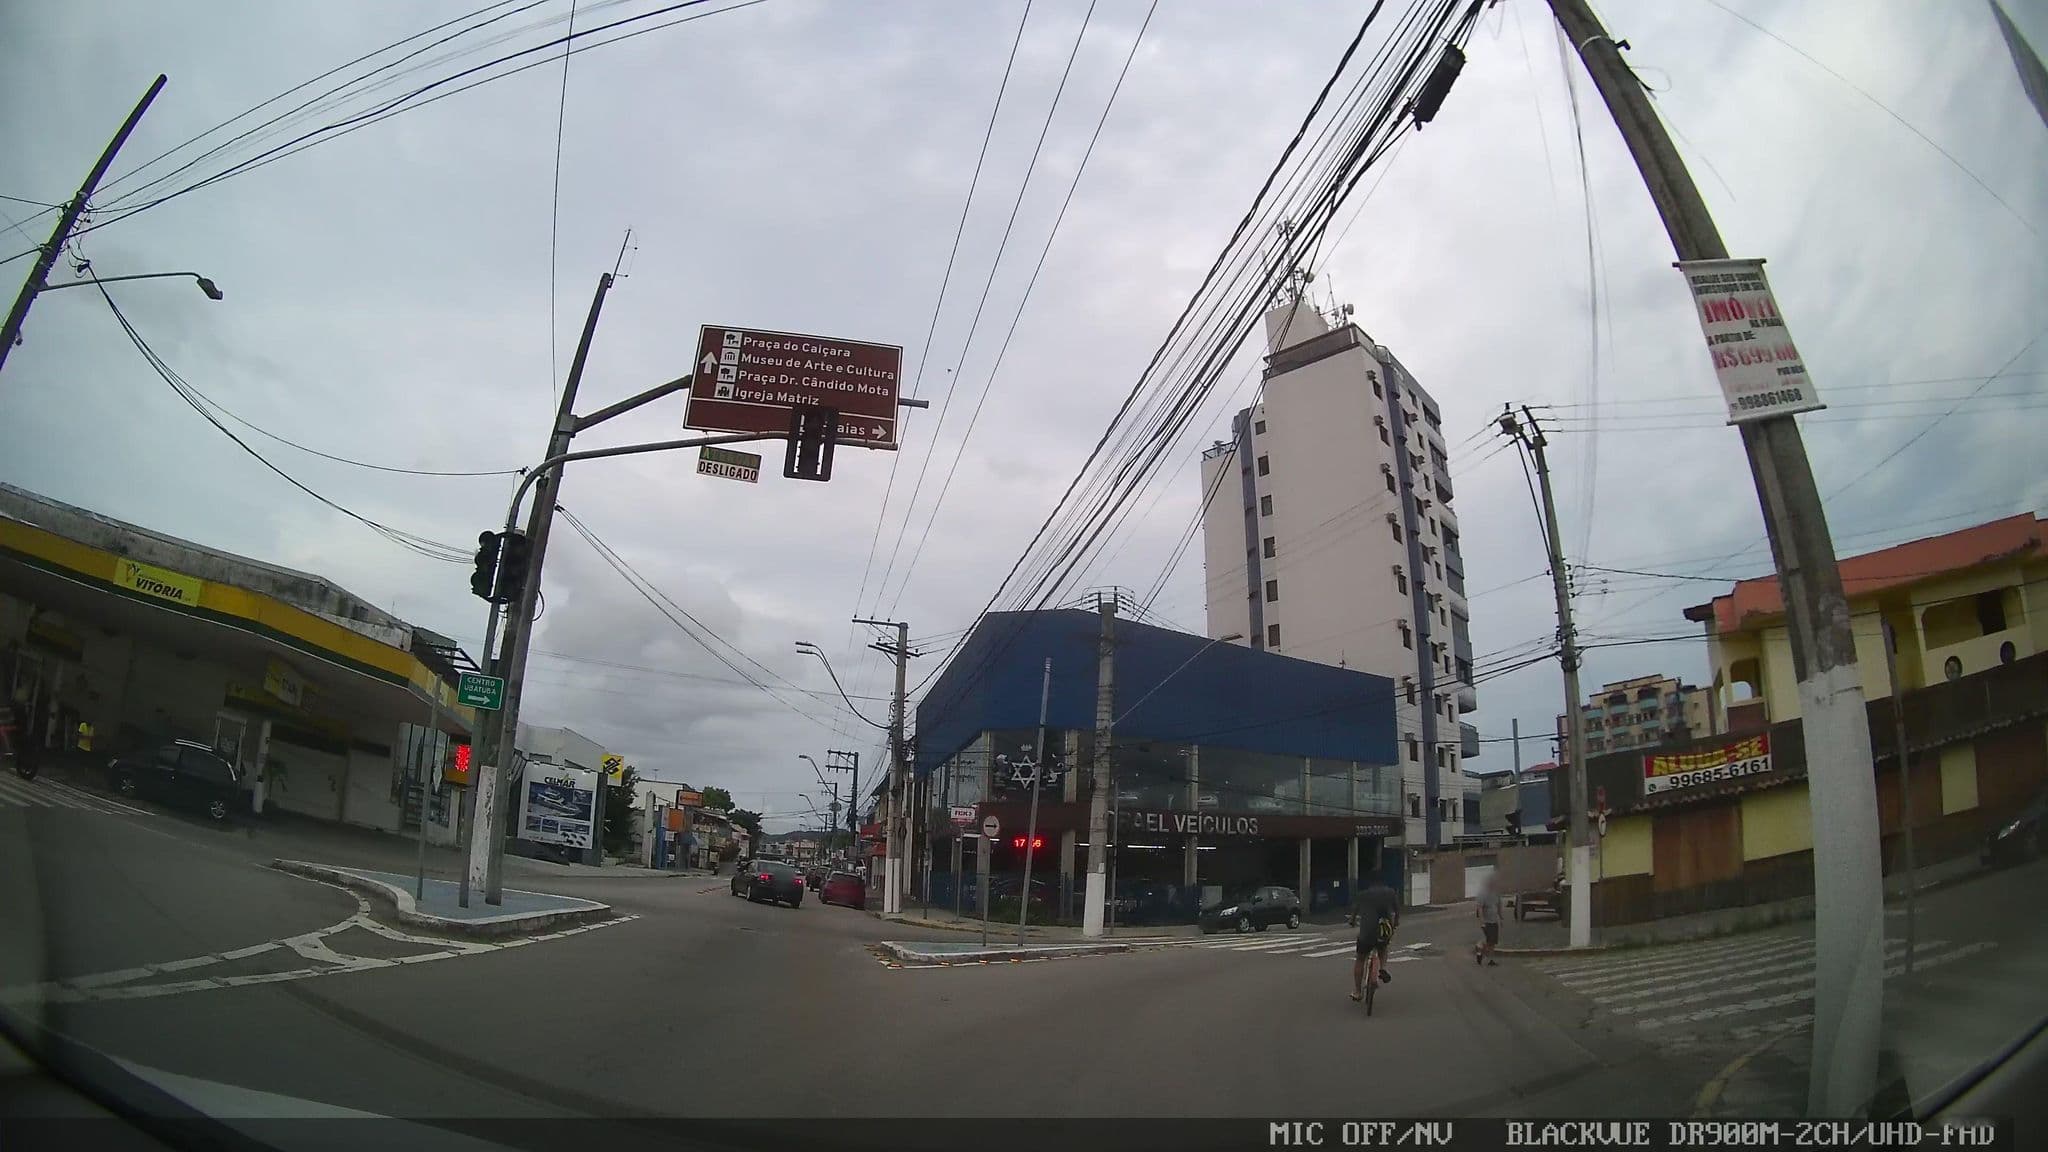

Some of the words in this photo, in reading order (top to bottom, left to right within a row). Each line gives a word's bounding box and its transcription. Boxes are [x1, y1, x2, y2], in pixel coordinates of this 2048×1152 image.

[743, 337, 781, 351] Praça
[783, 341, 799, 351] do
[802, 343, 852, 358] Caiçara
[741, 352, 783, 366] Museu
[785, 358, 801, 368] de
[804, 360, 833, 372] Arte
[836, 365, 844, 373] e
[846, 364, 895, 380] Cultura
[738, 370, 776, 385] Praça
[779, 374, 799, 386] Dr.
[802, 376, 854, 392] Cândido
[857, 383, 889, 396] Mota
[735, 388, 774, 402] Igreja
[776, 391, 820, 406] Matriz
[837, 423, 866, 435] aias
[699, 461, 757, 481] DESLIGADO
[464, 684, 497, 695] UBATUBA
[467, 676, 496, 687] CENTRO
[544, 776, 576, 788] CELMAR
[1670, 757, 1769, 788] 99685-6161
[1174, 811, 1259, 836] VEÍCULOS
